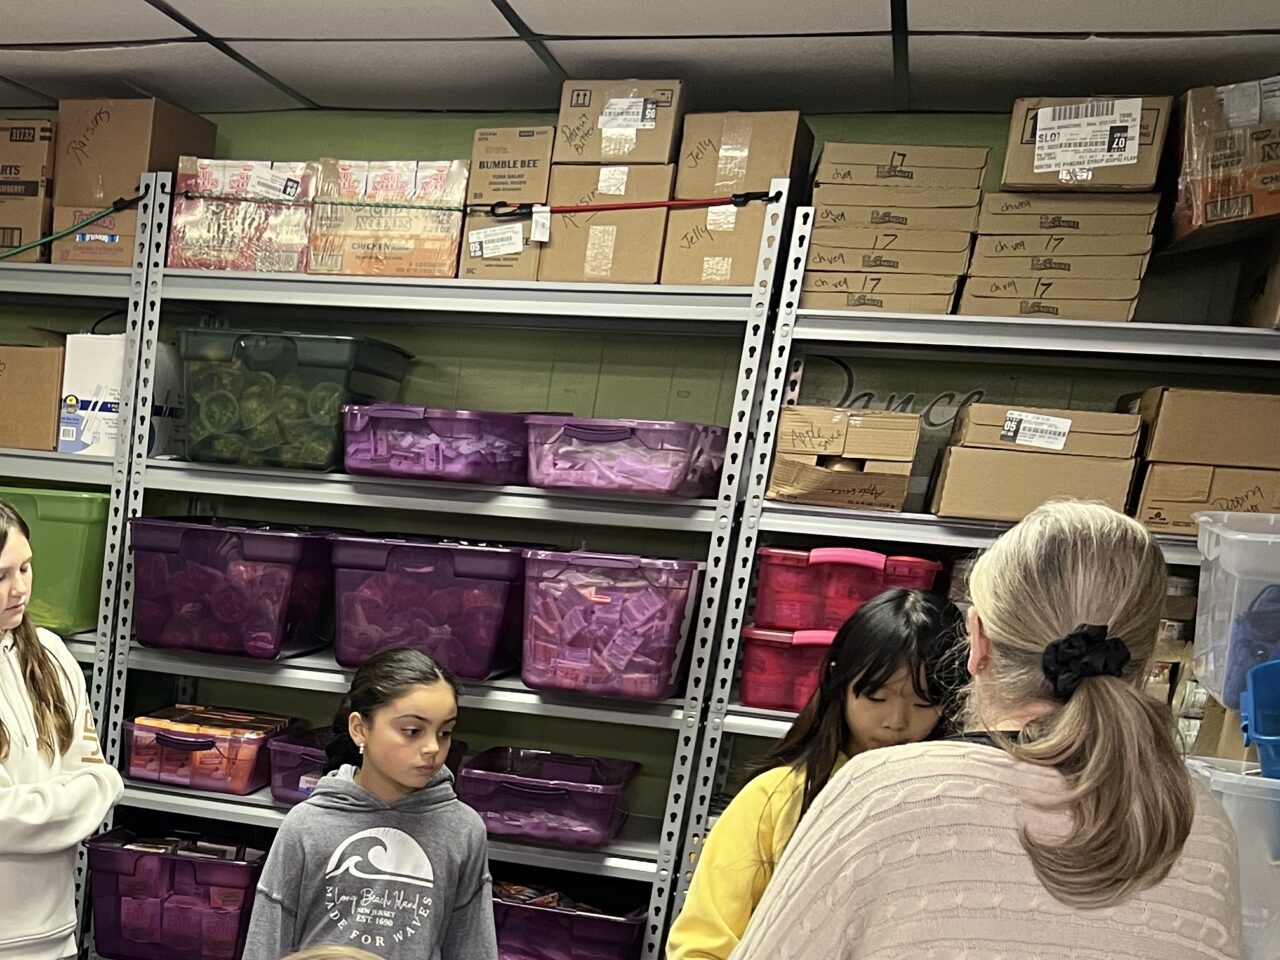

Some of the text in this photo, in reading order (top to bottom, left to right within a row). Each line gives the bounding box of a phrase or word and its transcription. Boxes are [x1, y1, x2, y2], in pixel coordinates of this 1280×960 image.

[478, 159, 539, 170] BUMBLE BEE
[686, 137, 719, 169] Jelly
[679, 222, 715, 250] Jelly
[325, 886, 433, 947] MADE FOR WAVES
